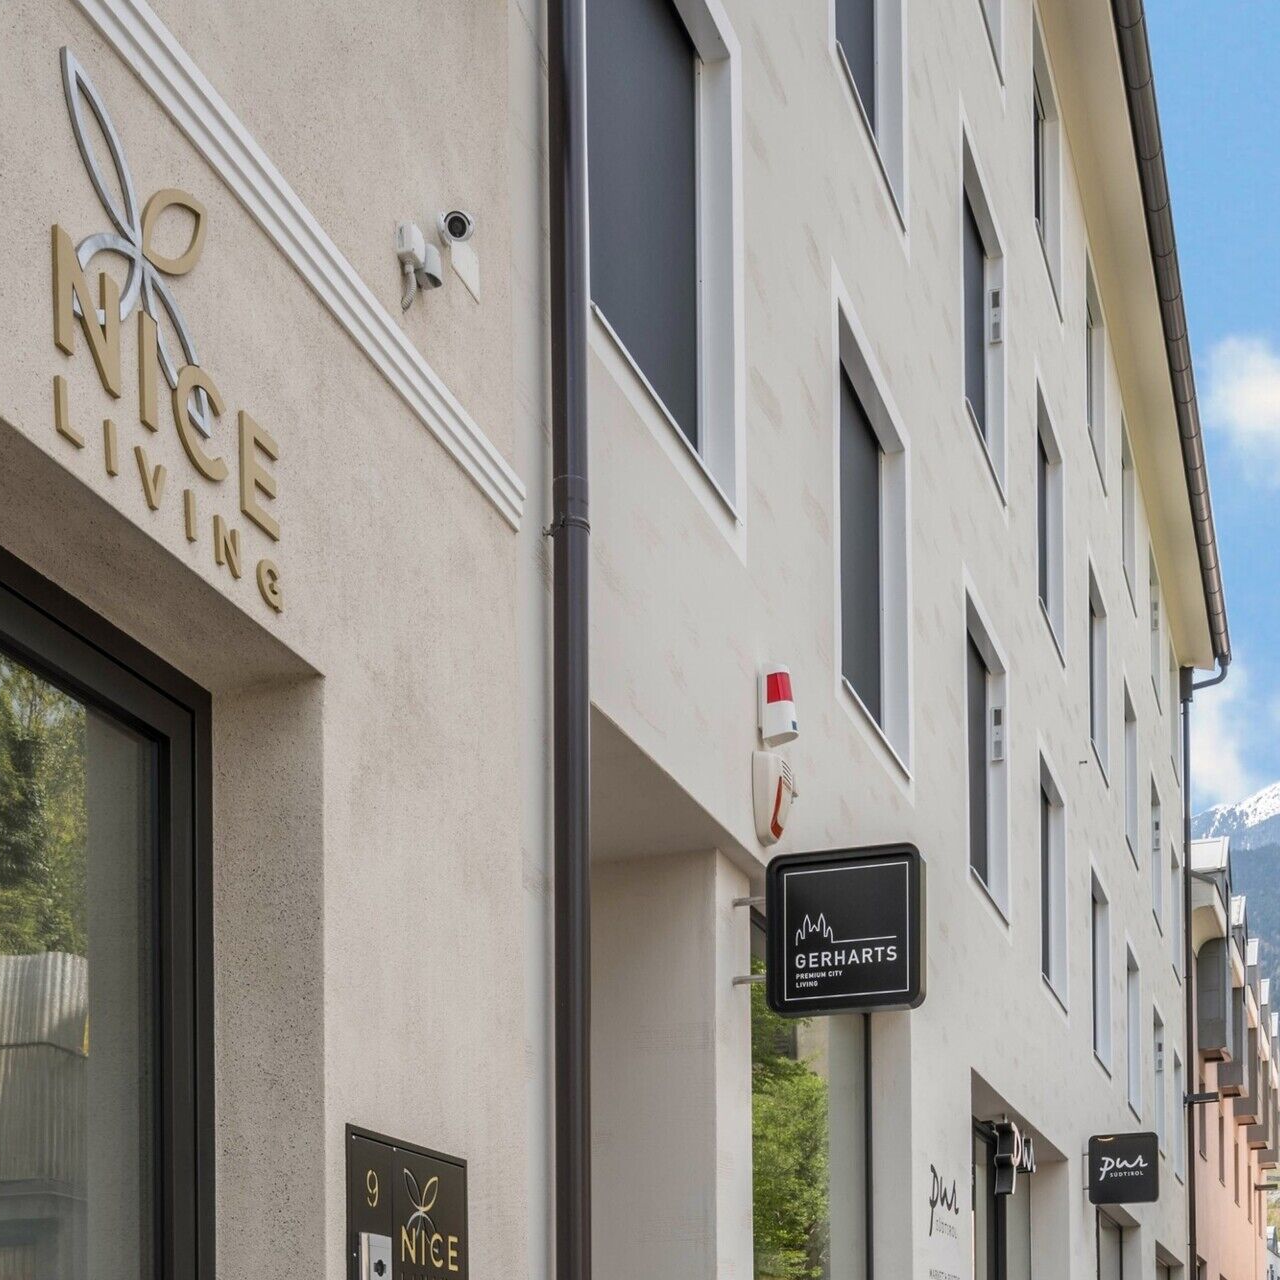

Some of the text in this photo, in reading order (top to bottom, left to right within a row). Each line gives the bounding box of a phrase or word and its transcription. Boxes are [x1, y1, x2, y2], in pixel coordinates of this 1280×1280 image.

[52, 223, 280, 541] NICE
[54, 375, 283, 614] LIVING
[795, 946, 897, 968] GERHARTS
[795, 972, 827, 980] PREMIUM
[795, 980, 818, 989] LIVING
[1099, 1154, 1149, 1182] pur
[1109, 1170, 1144, 1178] SÜDTIROL
[366, 1169, 379, 1208] 9
[929, 1163, 960, 1237] pur
[401, 1225, 459, 1272] NICE
